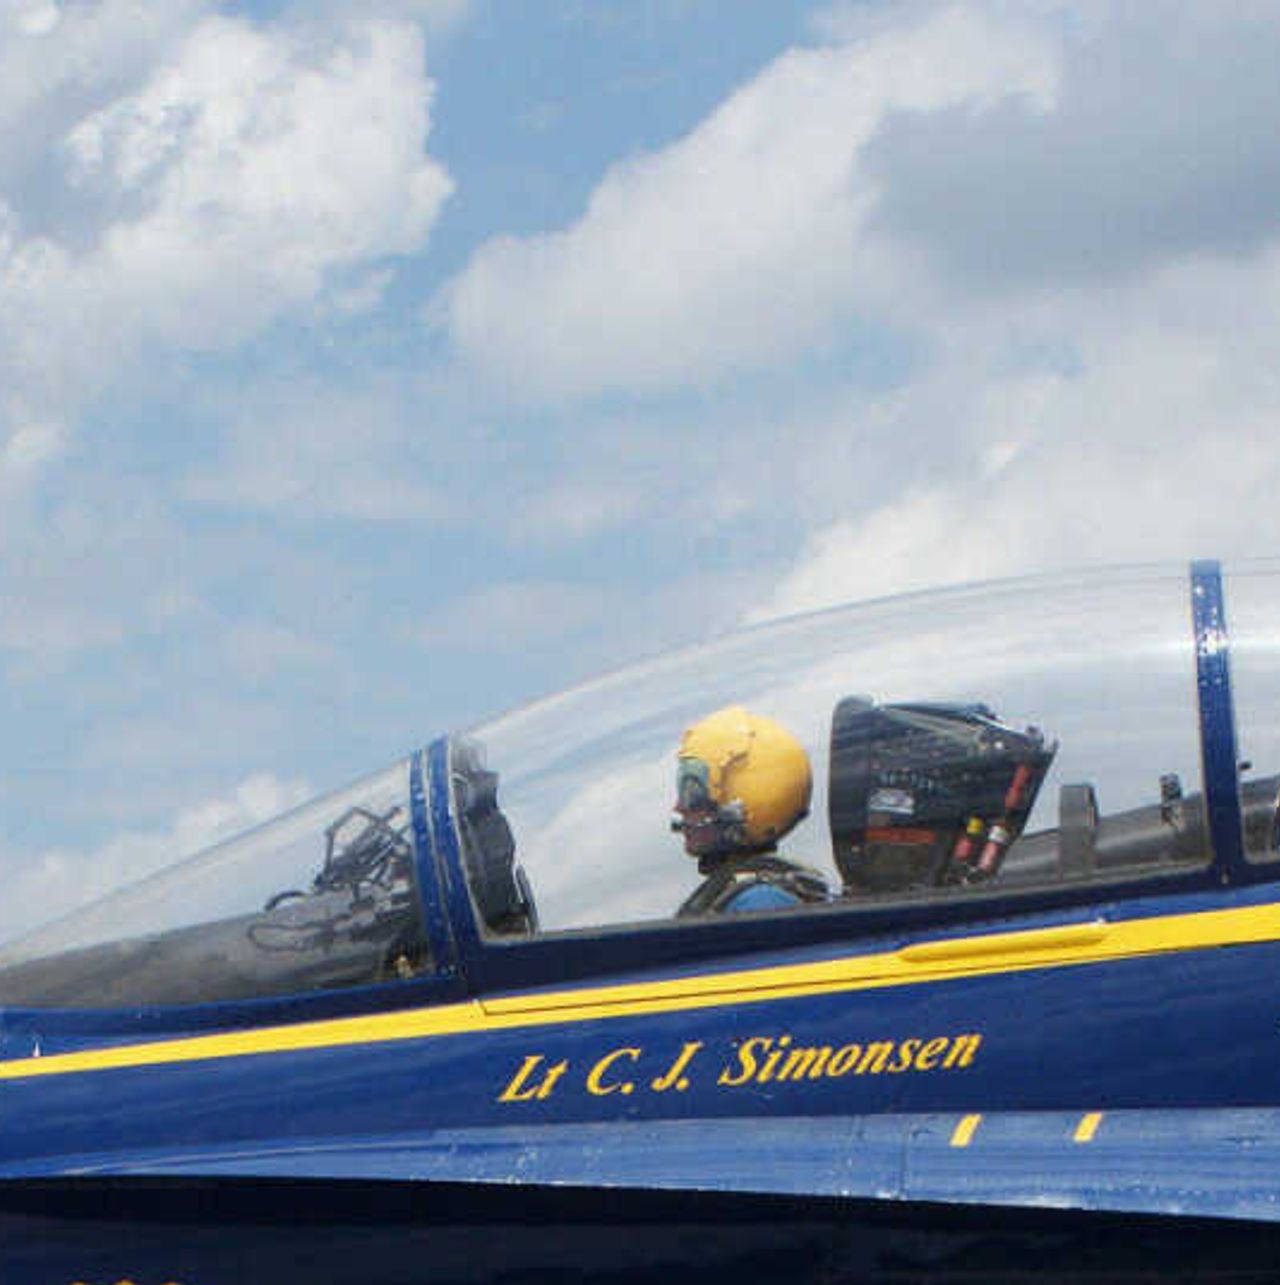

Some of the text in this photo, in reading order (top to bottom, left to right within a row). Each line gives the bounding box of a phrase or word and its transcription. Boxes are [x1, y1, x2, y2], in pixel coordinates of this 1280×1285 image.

[499, 1033, 982, 1102] Lt C. J. Simonsen
